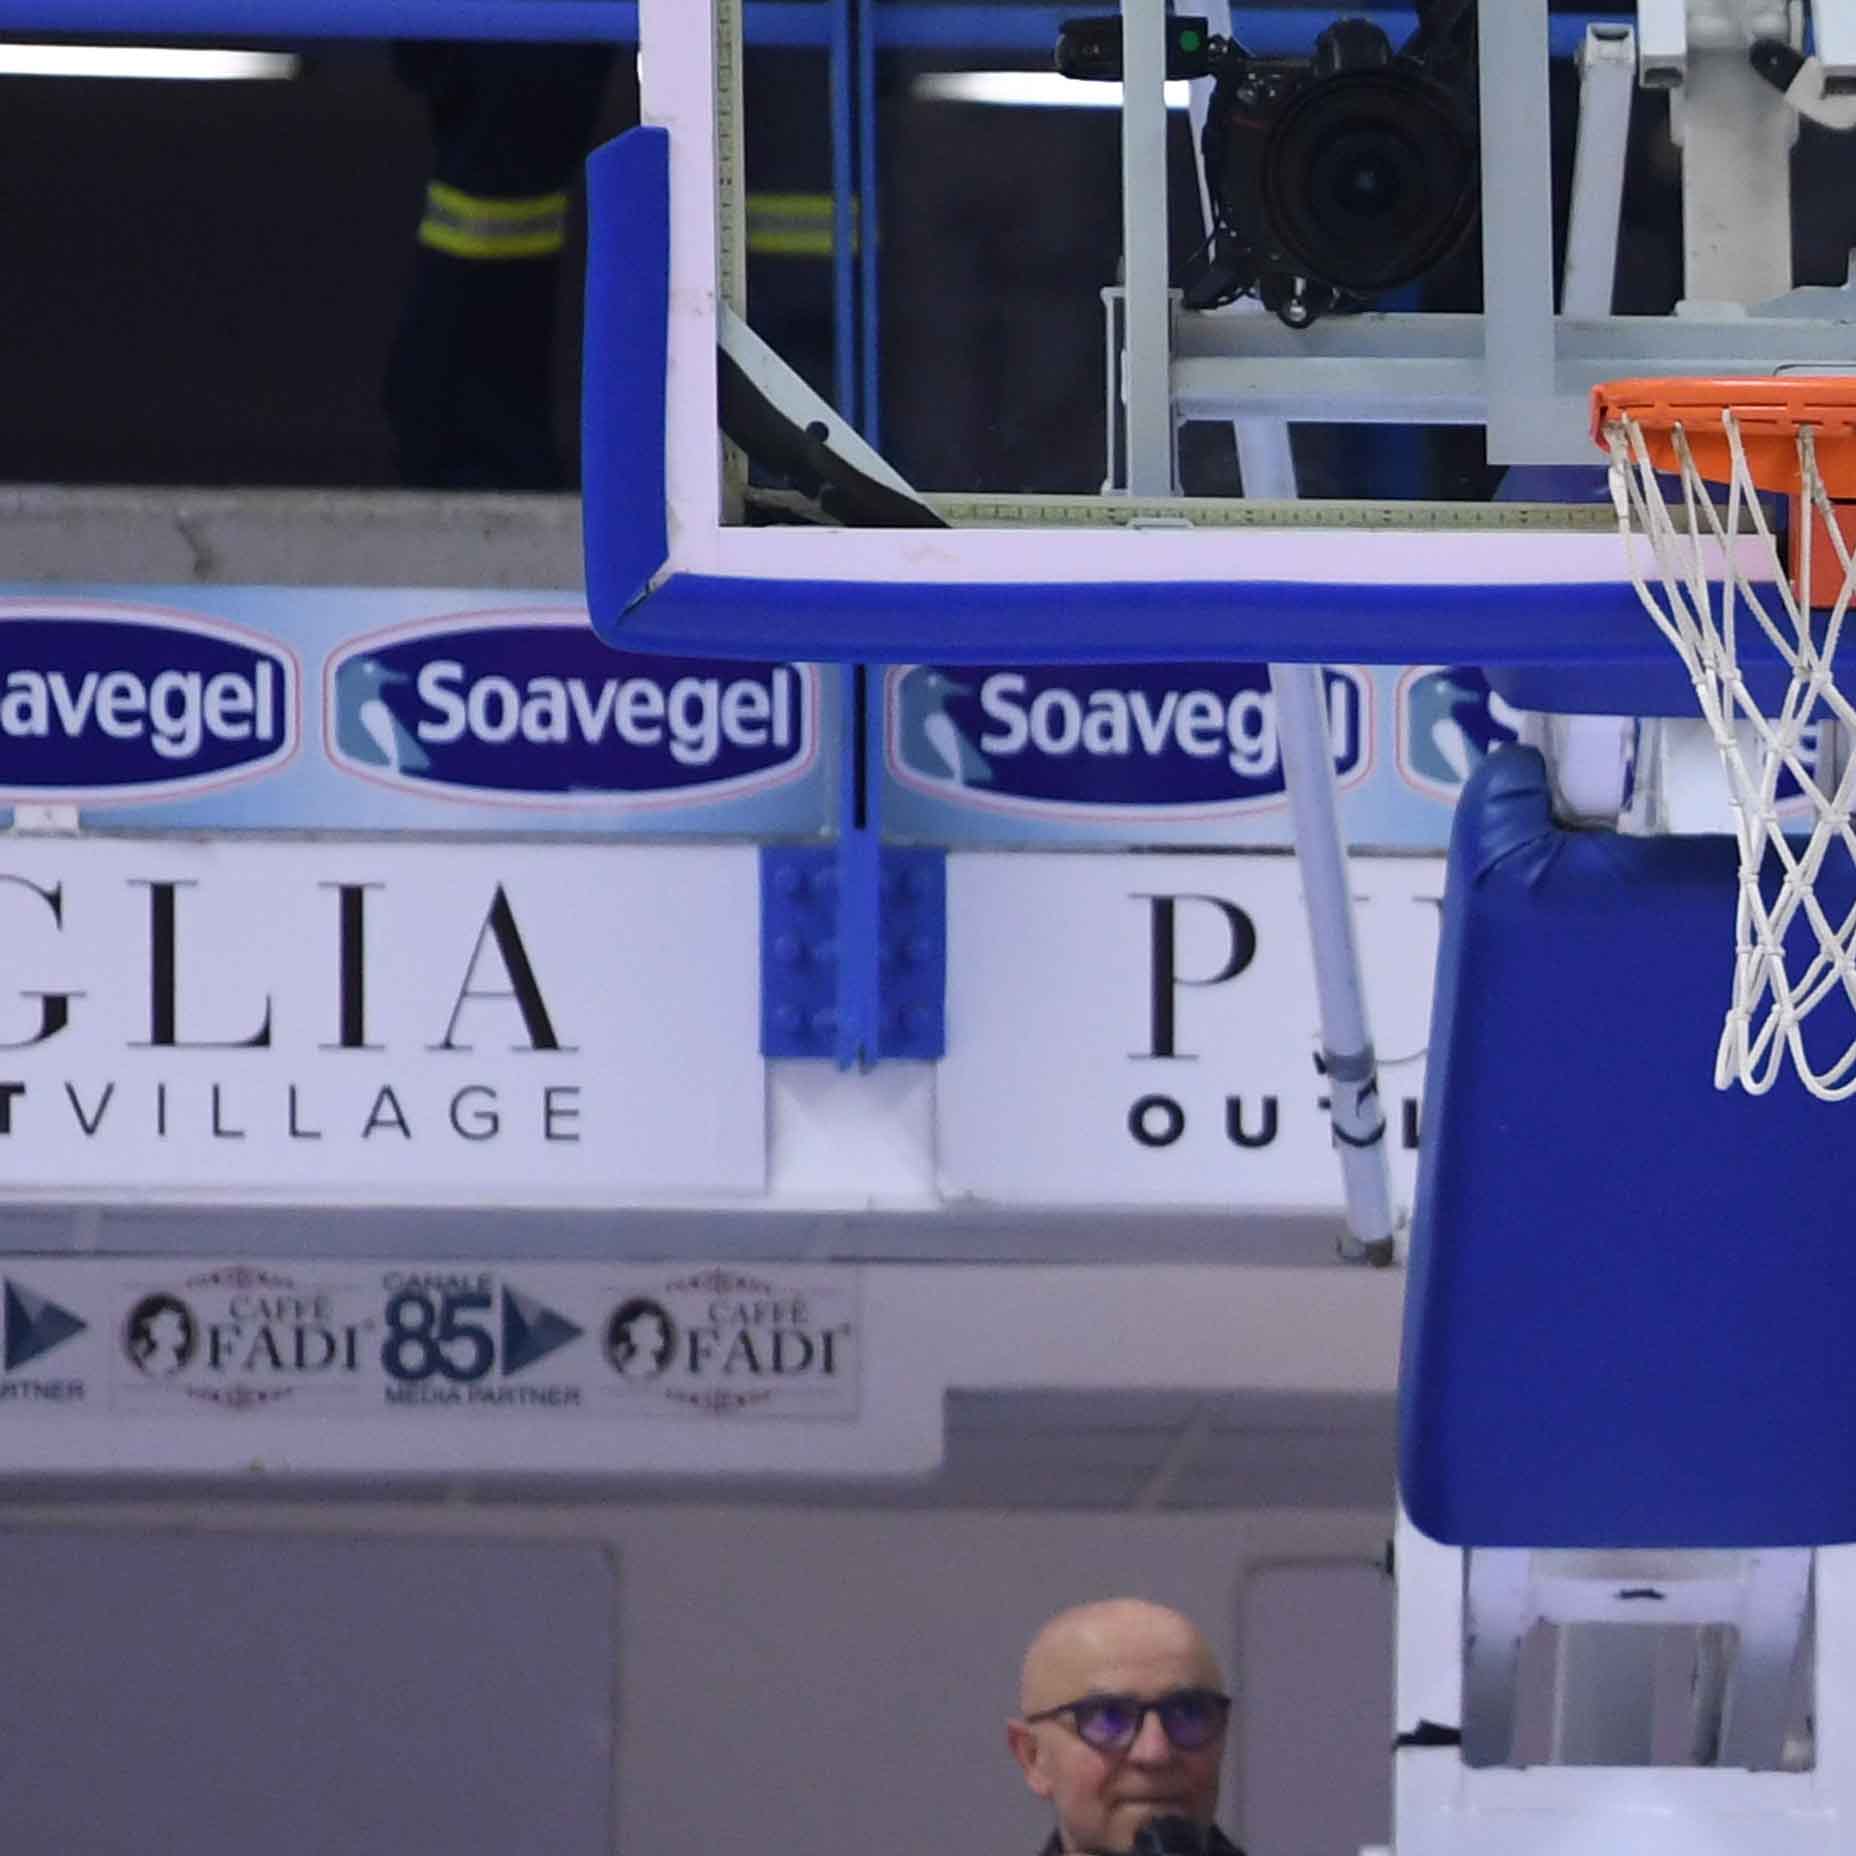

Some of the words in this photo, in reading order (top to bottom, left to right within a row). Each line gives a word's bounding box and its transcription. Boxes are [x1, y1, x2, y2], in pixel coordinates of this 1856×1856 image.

[0, 660, 273, 758] avegel
[416, 660, 791, 764] Soavegel
[979, 672, 1350, 778] Soavegl
[0, 876, 582, 1052] GLIA
[207, 1324, 359, 1371] FADI
[380, 1293, 495, 1382] 85
[686, 1329, 837, 1375] FADI
